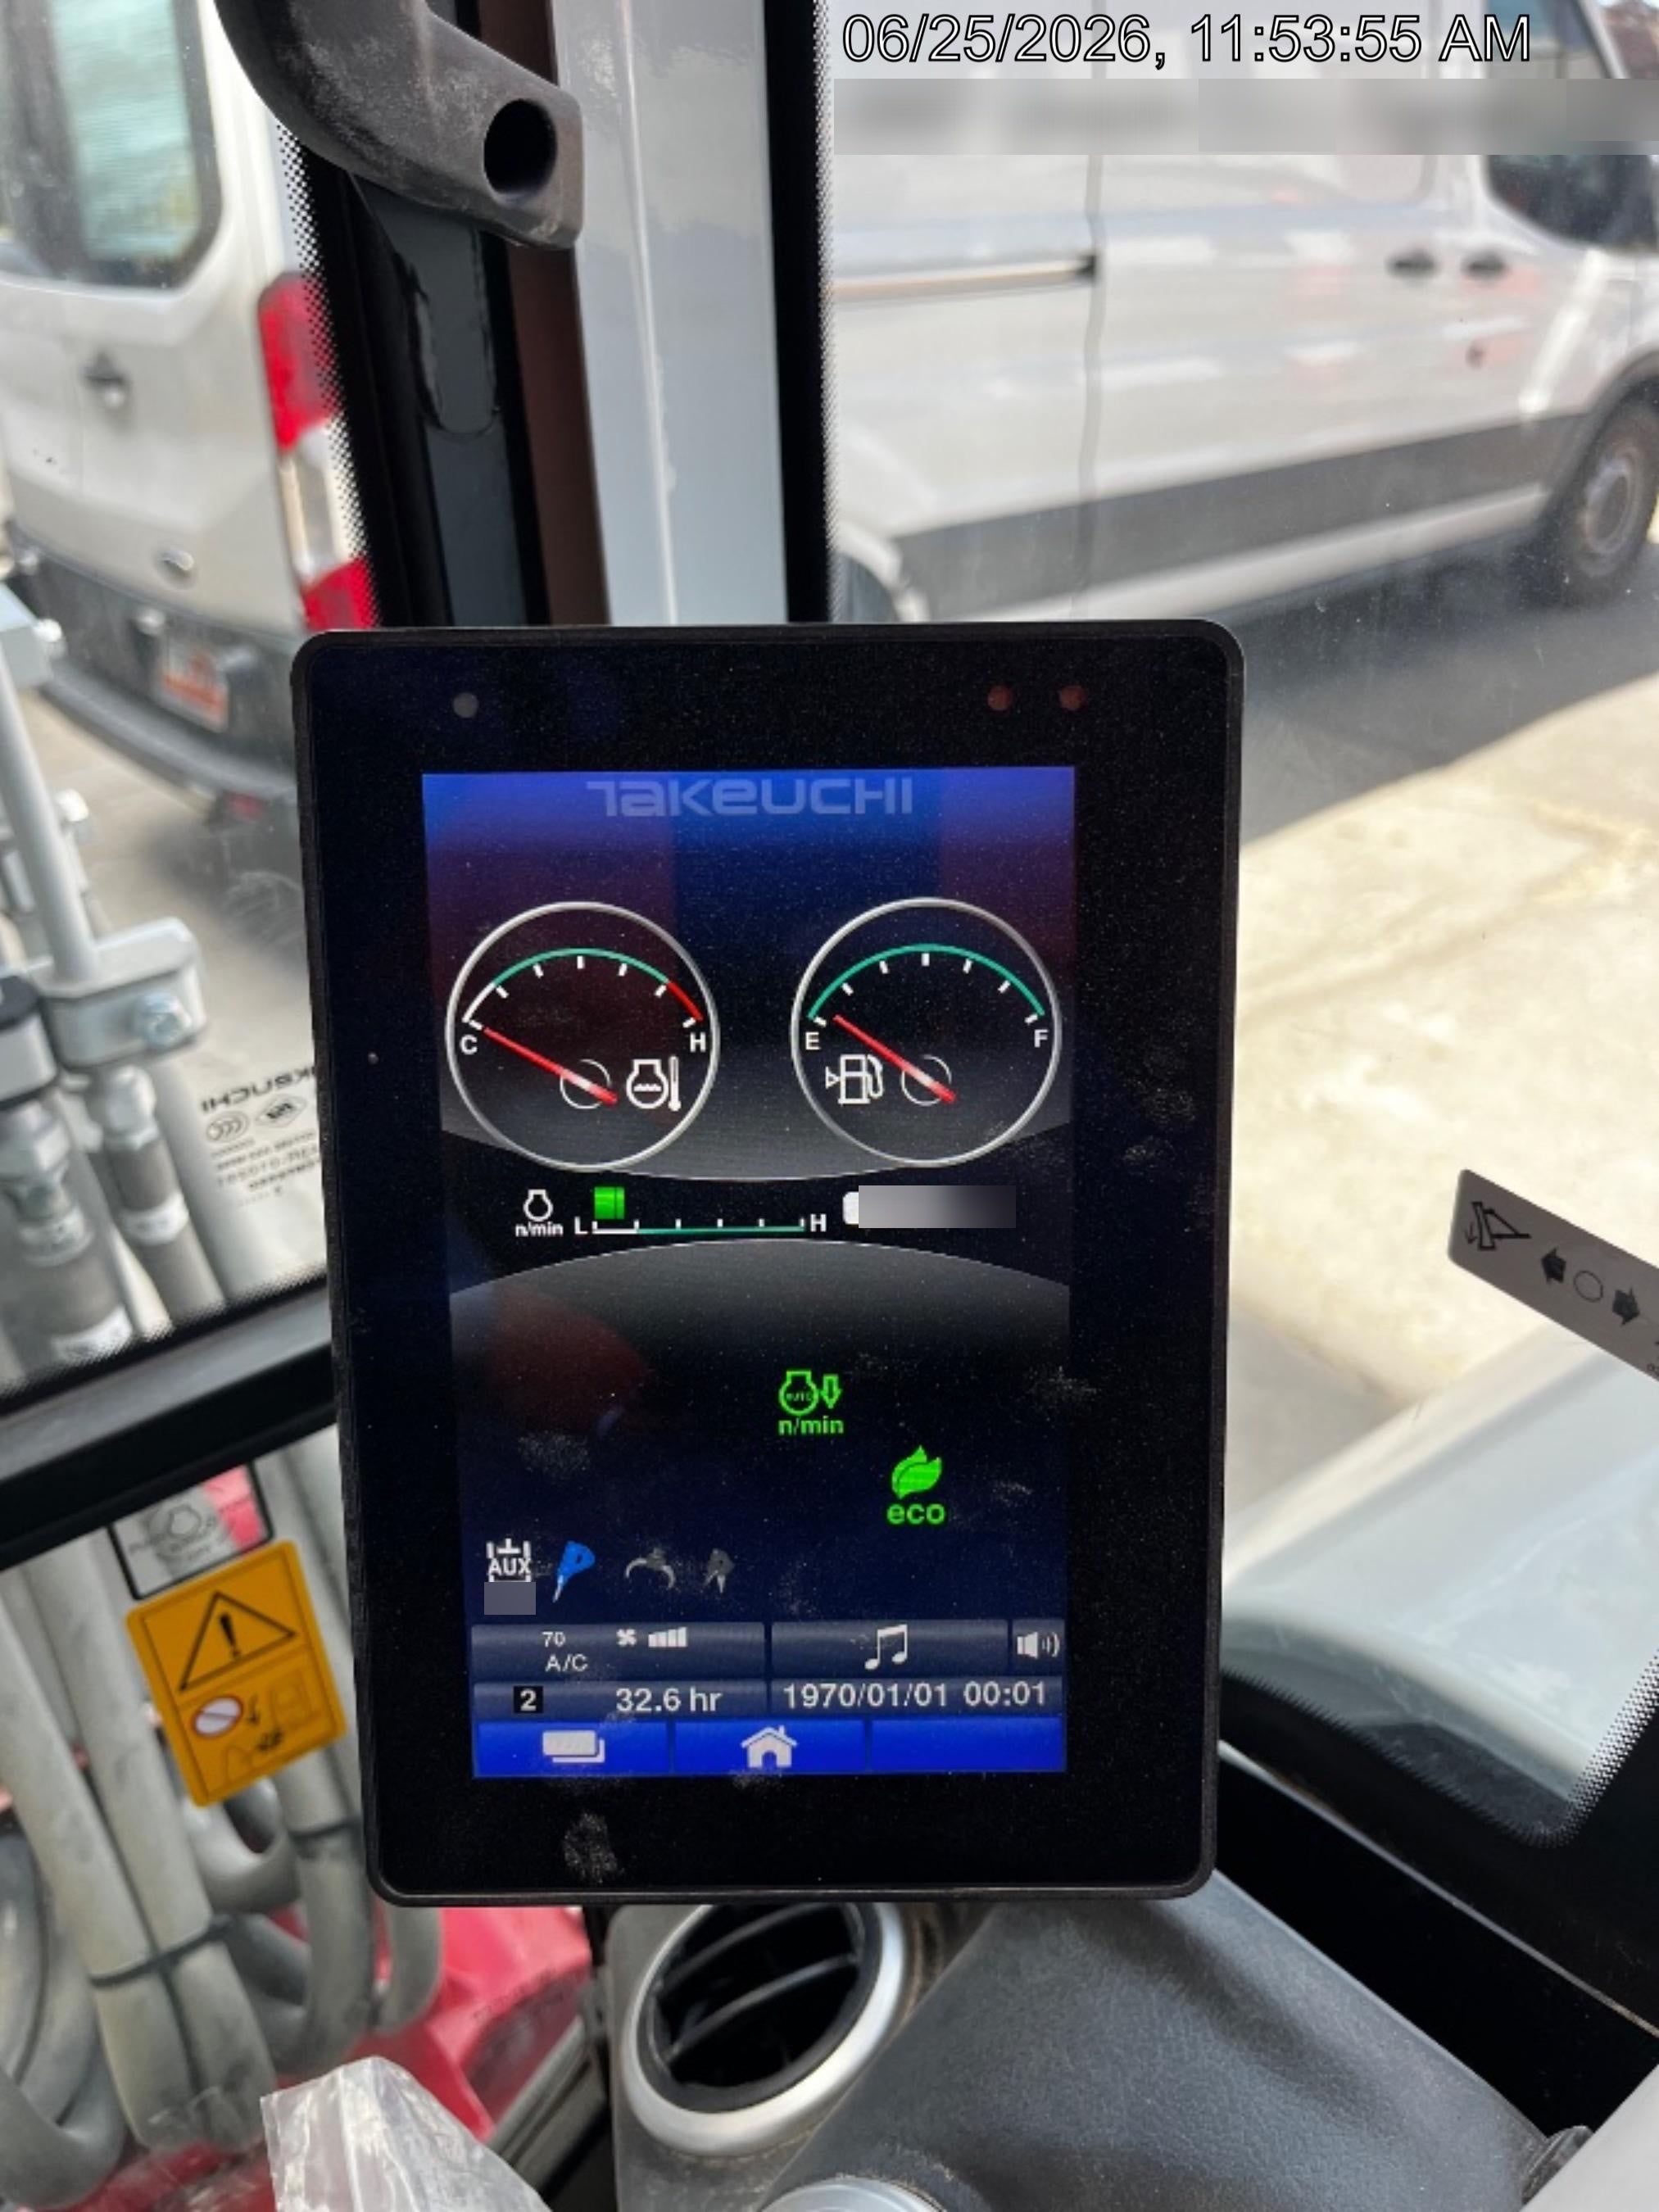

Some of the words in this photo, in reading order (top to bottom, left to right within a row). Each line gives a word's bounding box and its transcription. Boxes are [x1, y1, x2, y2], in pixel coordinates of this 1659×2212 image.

[460, 1035, 478, 1055] C
[690, 1033, 707, 1054] H
[805, 1031, 821, 1052] E
[1034, 1029, 1049, 1049] F
[515, 1220, 564, 1238] n/min
[574, 1217, 588, 1235] L
[810, 1213, 827, 1234] H
[777, 1414, 845, 1437] n/min
[886, 1503, 946, 1525] eco
[487, 1557, 533, 1577] AUX
[542, 1631, 567, 1648] 70
[545, 1653, 589, 1673] A/C
[519, 1690, 538, 1712] 2
[615, 1688, 682, 1713] 32.6
[690, 1688, 723, 1712] hr
[783, 1682, 948, 1709] 1970/01/01
[963, 1680, 1045, 1707] 00:01
